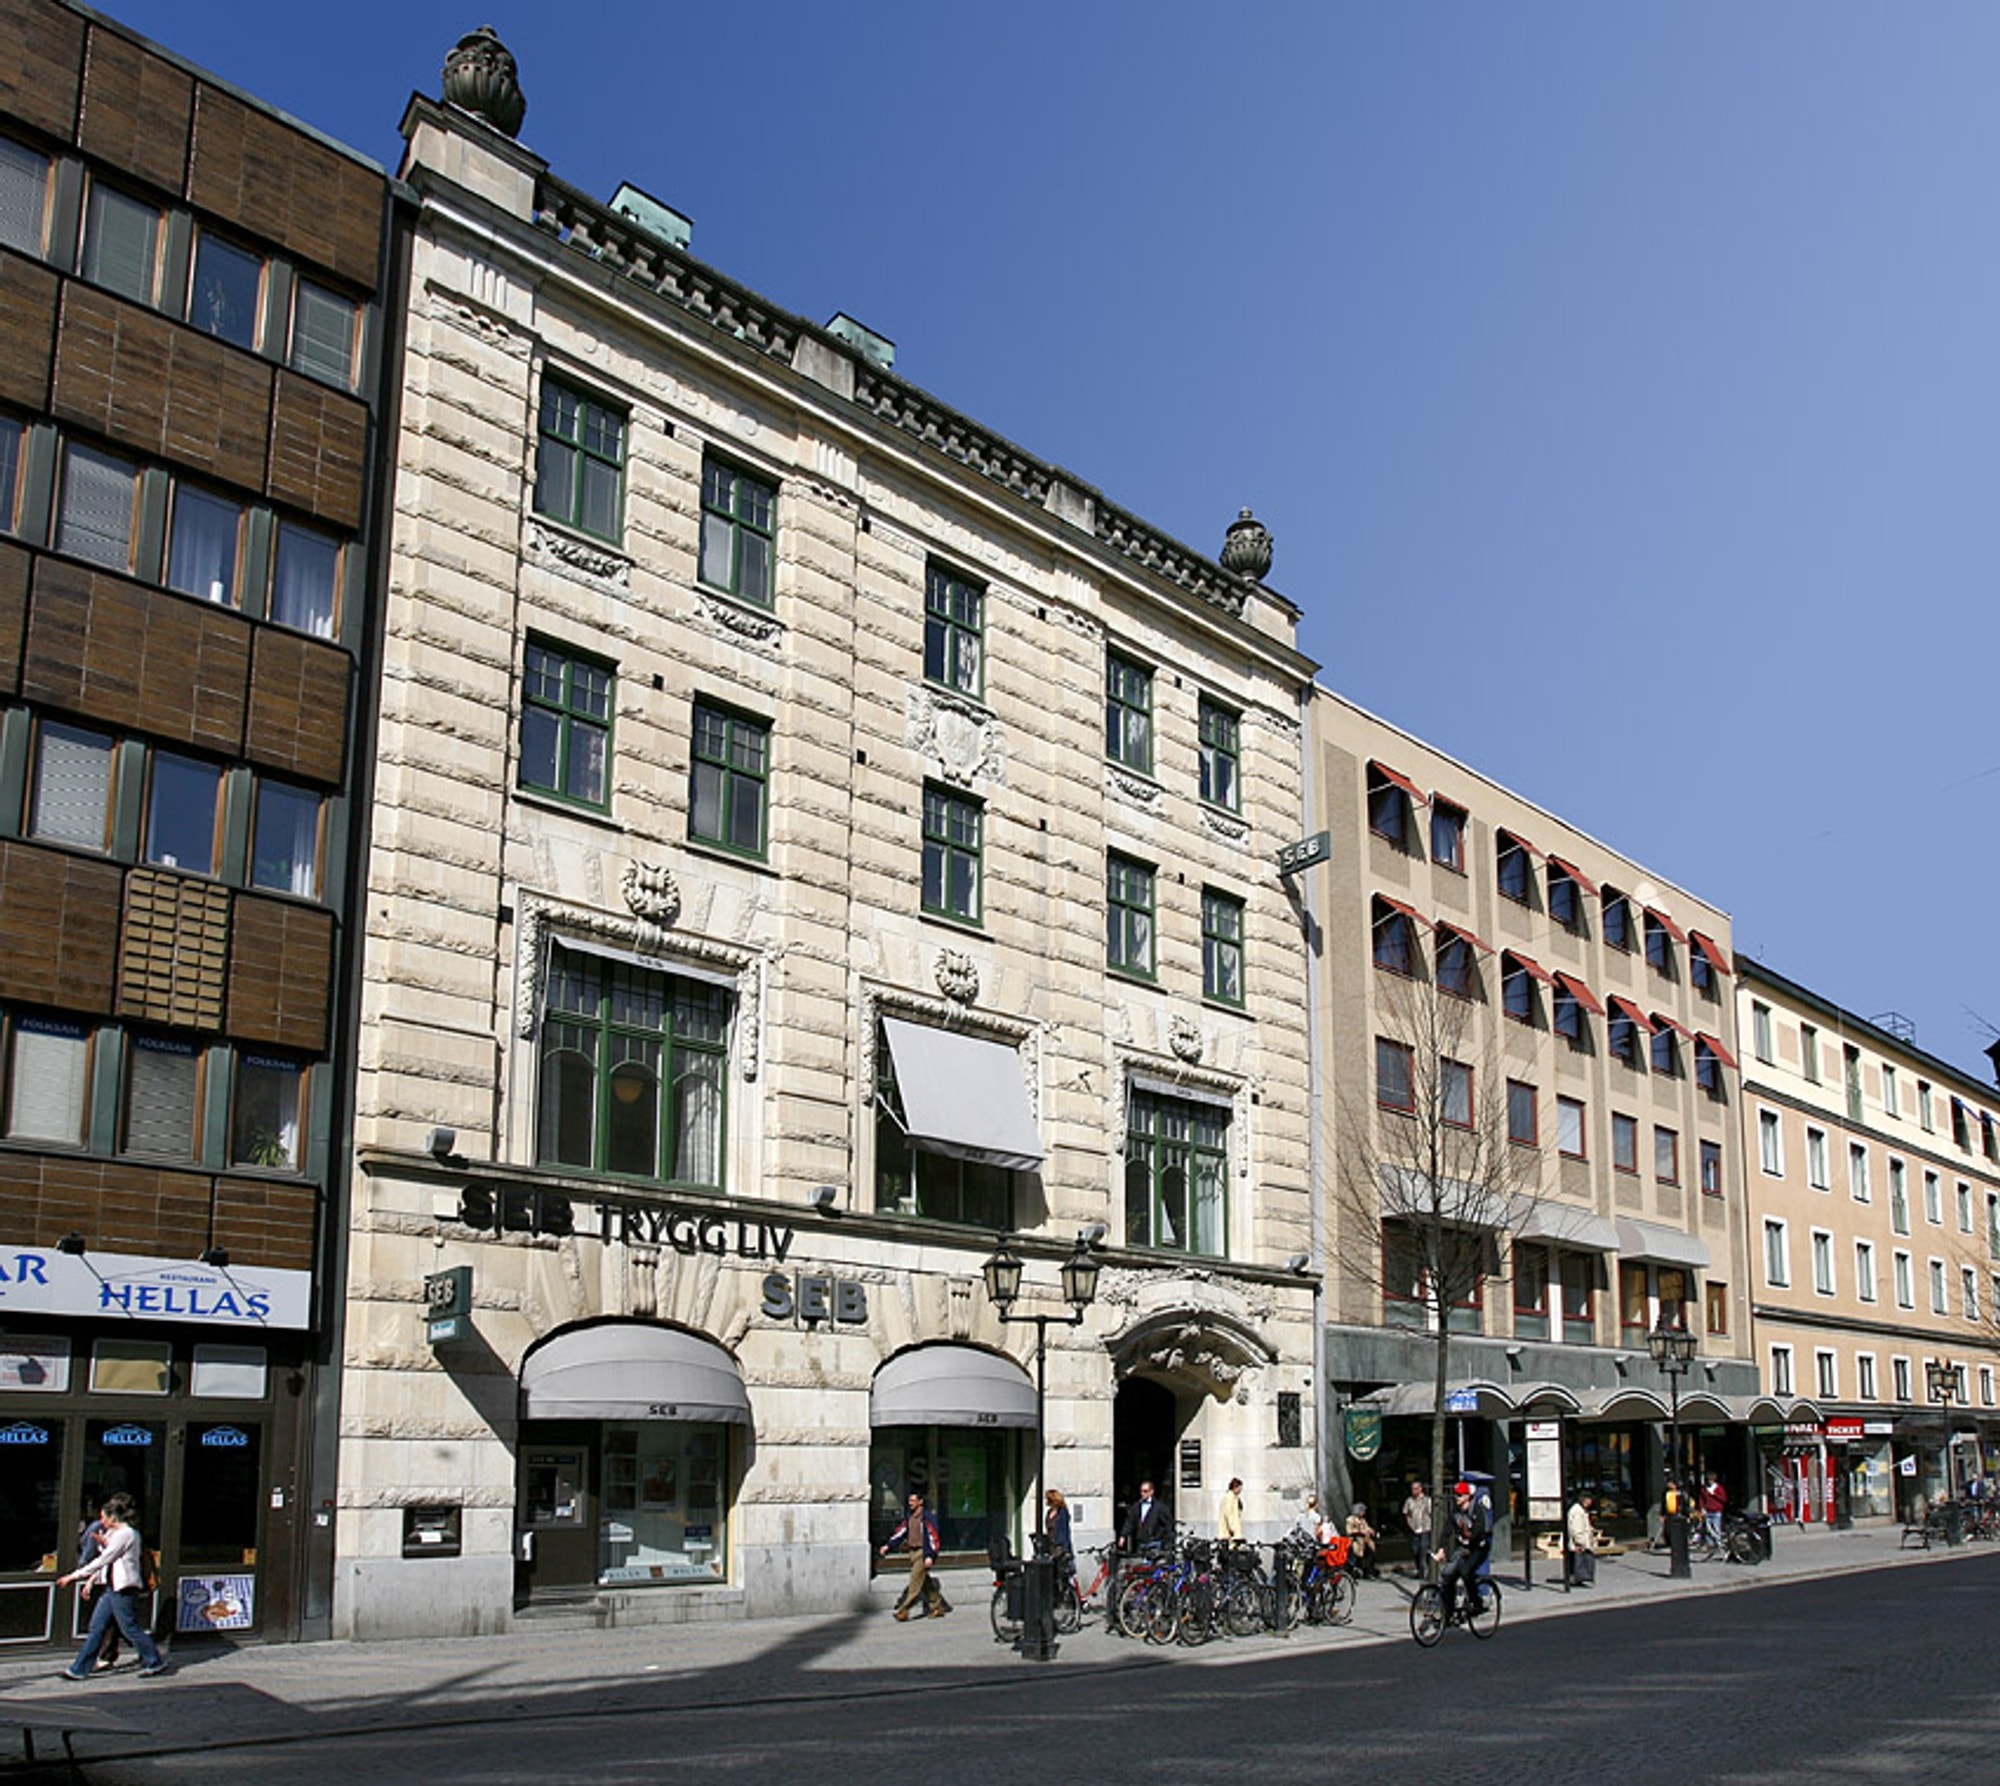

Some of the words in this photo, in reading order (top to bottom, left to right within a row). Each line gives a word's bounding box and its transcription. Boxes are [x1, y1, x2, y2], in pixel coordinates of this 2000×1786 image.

[461, 1184, 574, 1238] SEB
[596, 1203, 727, 1258] TRYGG
[738, 1216, 794, 1264] LIV
[97, 1281, 270, 1318] HELLAS
[428, 1277, 454, 1305] SEB
[761, 1273, 868, 1325] SEB
[649, 1404, 678, 1416] SEB
[103, 1431, 152, 1446] HELLAS
[202, 1432, 248, 1447] HELLAS
